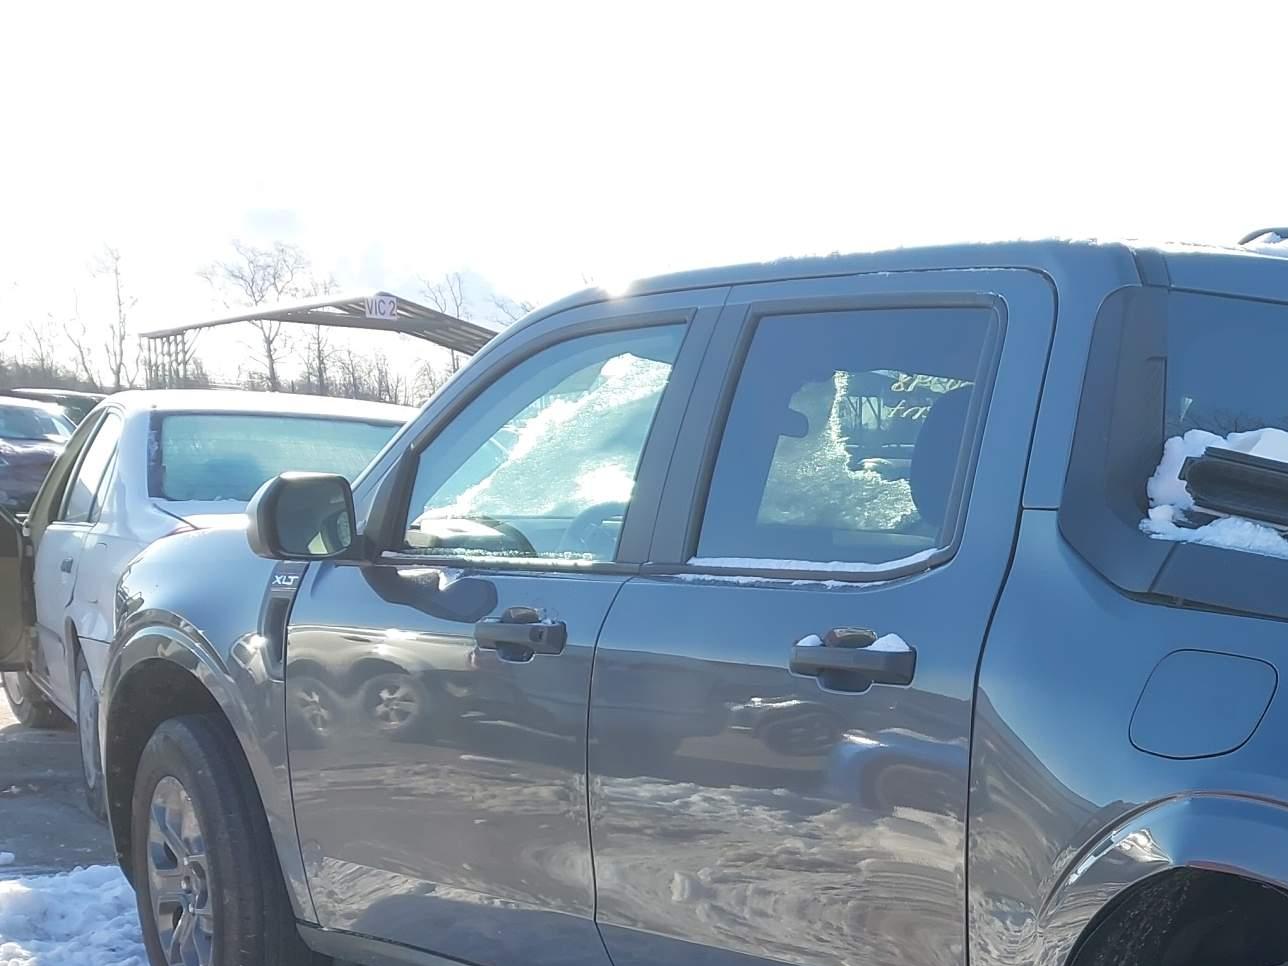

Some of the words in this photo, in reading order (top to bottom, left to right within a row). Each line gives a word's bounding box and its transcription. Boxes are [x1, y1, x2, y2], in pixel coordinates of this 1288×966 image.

[366, 298, 386, 316] VIC
[389, 300, 396, 316] 2
[271, 575, 299, 585] XLT
